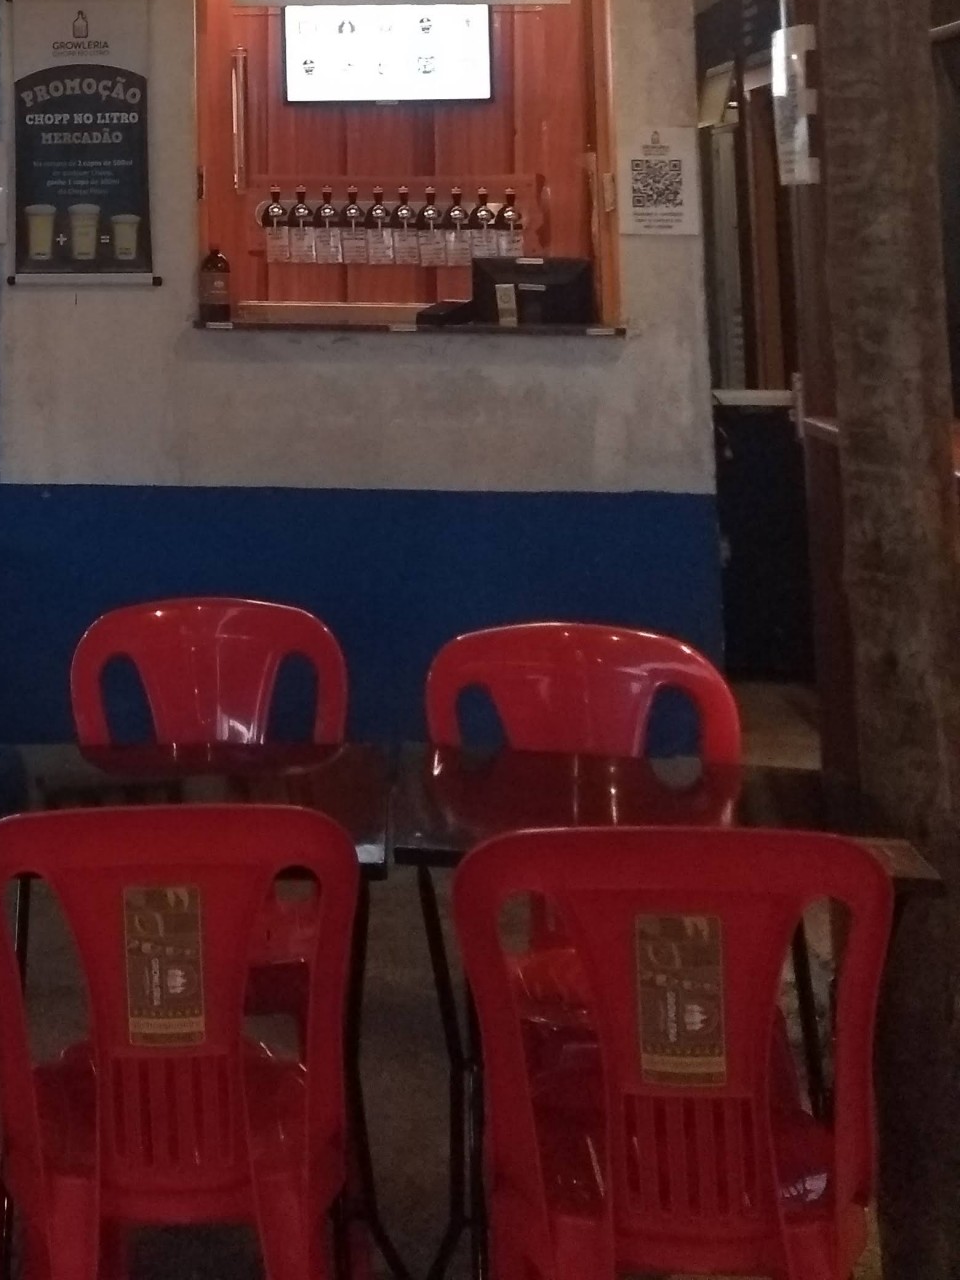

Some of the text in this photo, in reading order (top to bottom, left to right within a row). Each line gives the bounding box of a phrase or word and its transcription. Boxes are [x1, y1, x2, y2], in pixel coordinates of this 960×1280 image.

[52, 40, 109, 50] GROWLERIA
[21, 77, 141, 108] PROMOÇÃO
[25, 112, 139, 125] CHOPP NO LITRO
[41, 127, 123, 144] MERCADÃO
